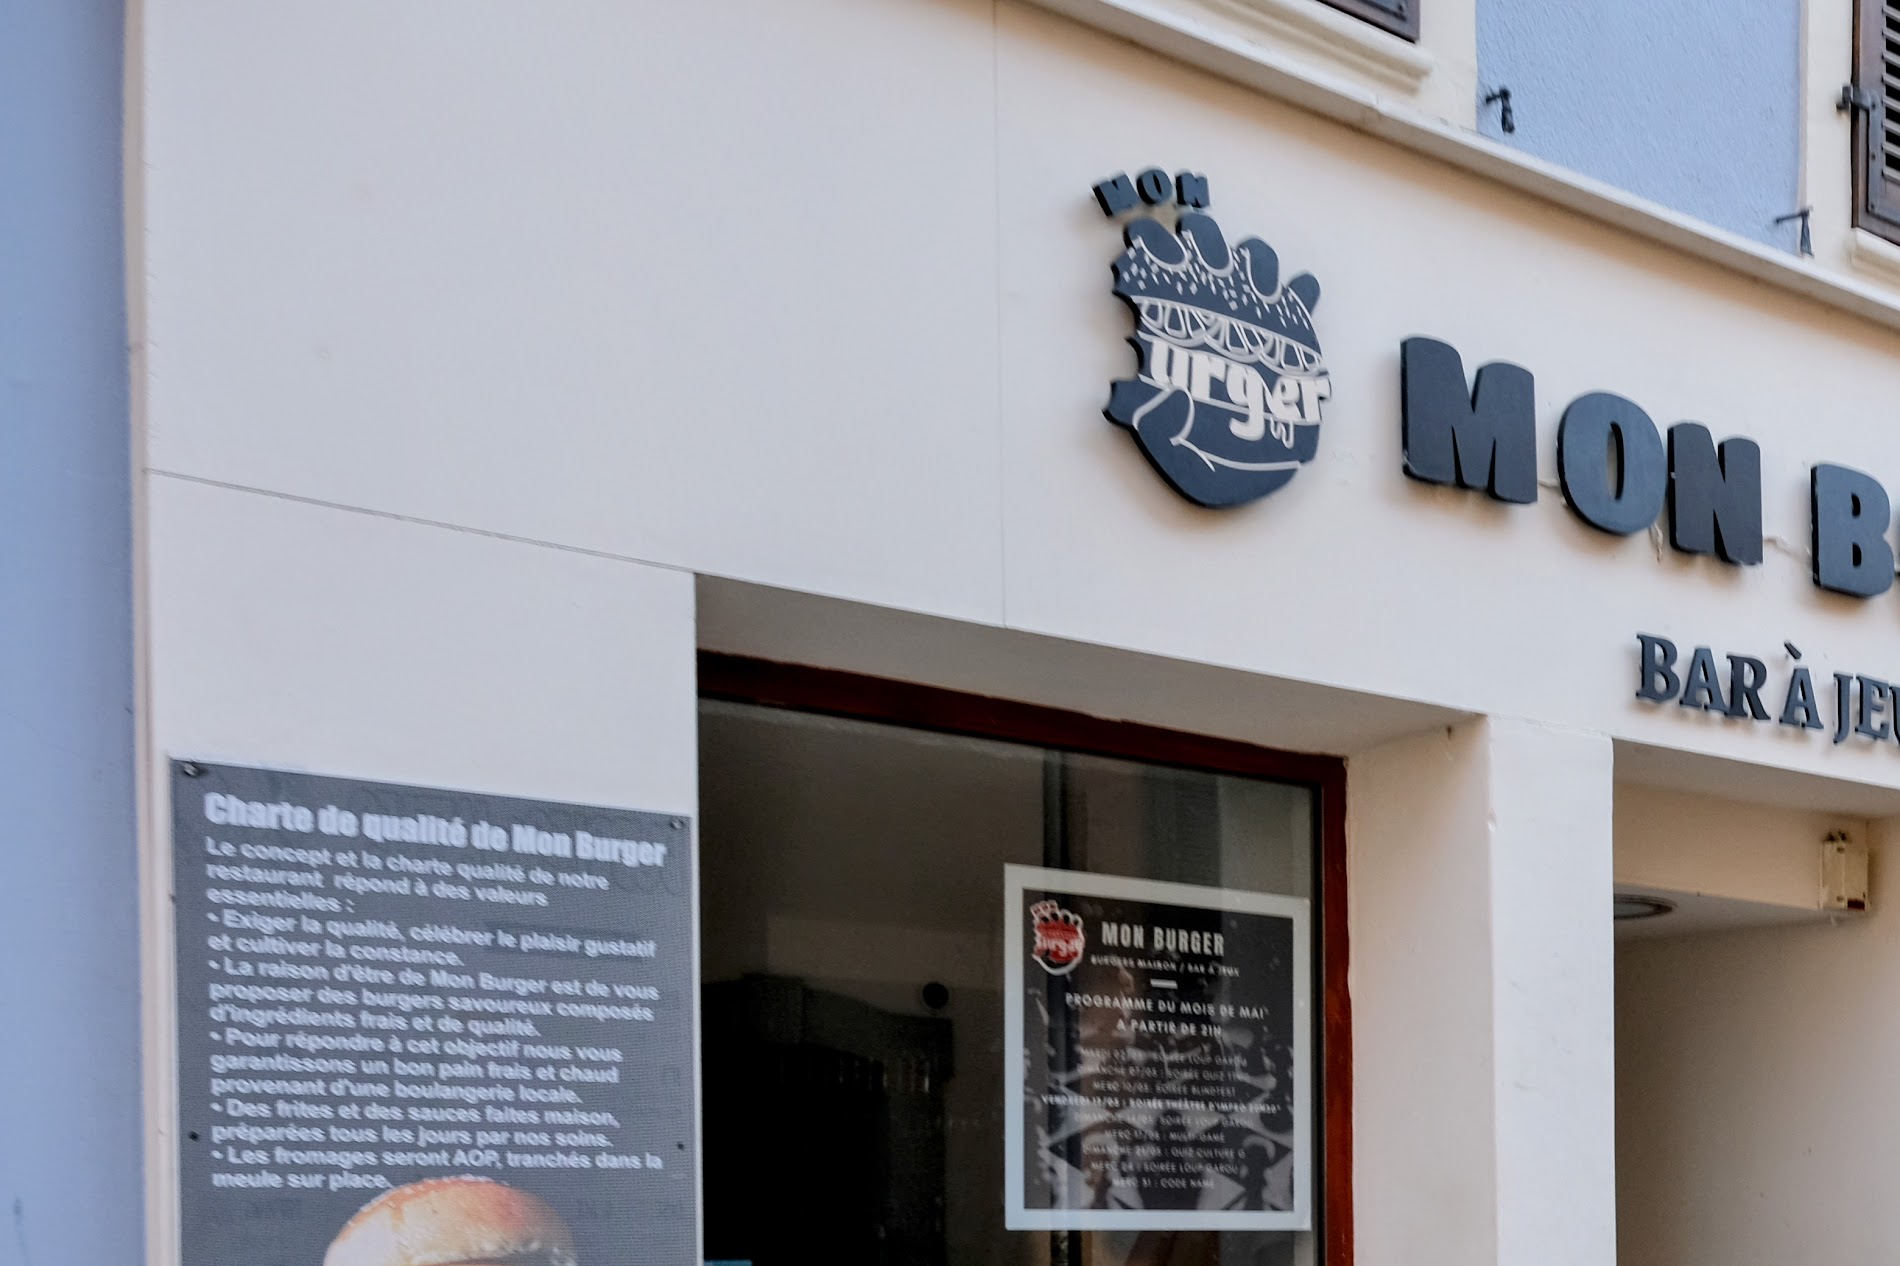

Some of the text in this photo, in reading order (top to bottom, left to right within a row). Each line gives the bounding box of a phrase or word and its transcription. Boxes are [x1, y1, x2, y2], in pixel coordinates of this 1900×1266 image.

[1091, 168, 1211, 217] MON
[1398, 333, 1763, 567] MON
[1634, 632, 1769, 724] BAR
[1778, 641, 1827, 731] À
[204, 792, 667, 867] Charte de qualité de Mon Burger
[1102, 921, 1224, 956] MON BURGER
[1065, 992, 1152, 1012] PROGRAMME
[1158, 999, 1175, 1013] DU
[1179, 1000, 1215, 1016] MOIS
[1219, 1003, 1234, 1017] DE
[1130, 1019, 1175, 1034] PARTIR
[1180, 1022, 1196, 1035] DE
